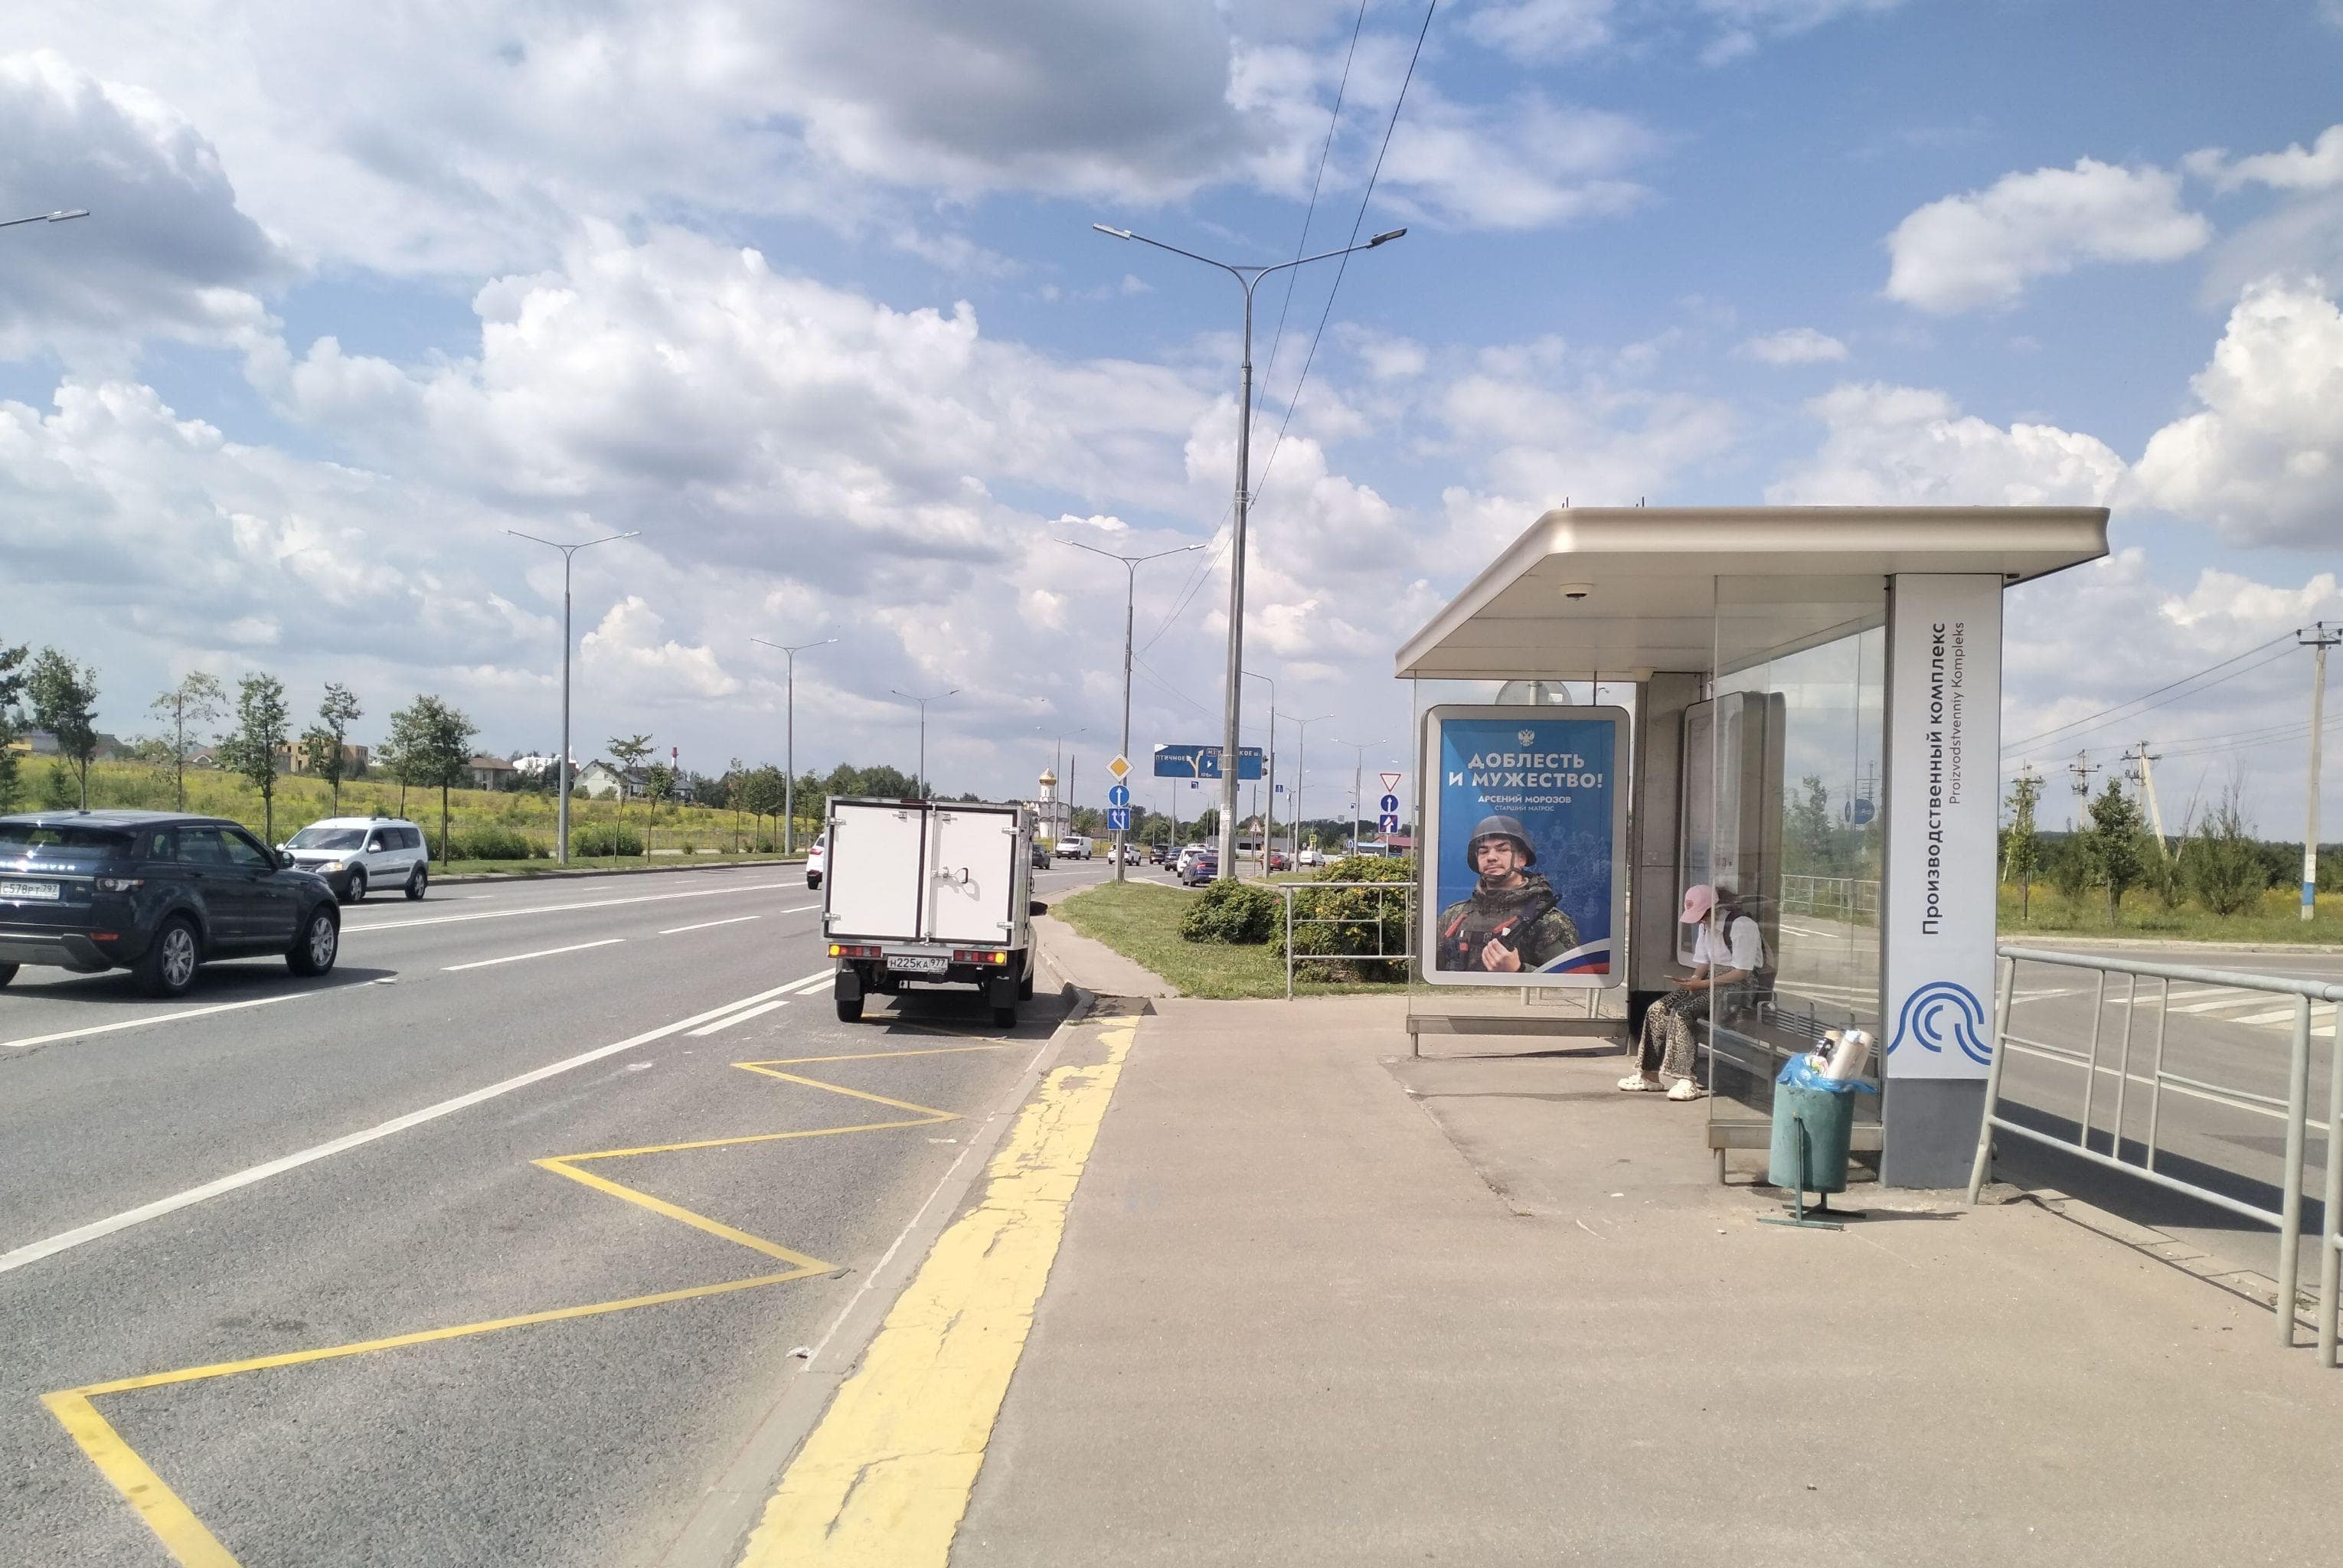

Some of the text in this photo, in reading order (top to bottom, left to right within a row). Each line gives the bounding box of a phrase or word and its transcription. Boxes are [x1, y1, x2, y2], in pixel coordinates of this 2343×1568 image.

[1949, 622, 1966, 805] Proizvodstvenniy Kompleks
[1468, 753, 1585, 769] ДОБЛЕСТЬ
[1449, 771, 1604, 788] И МУЖЕСТВО!
[1923, 622, 1945, 935] Производственный комплекс
[1478, 793, 1572, 804] АРСЕНИЙ МОРОЗОВ
